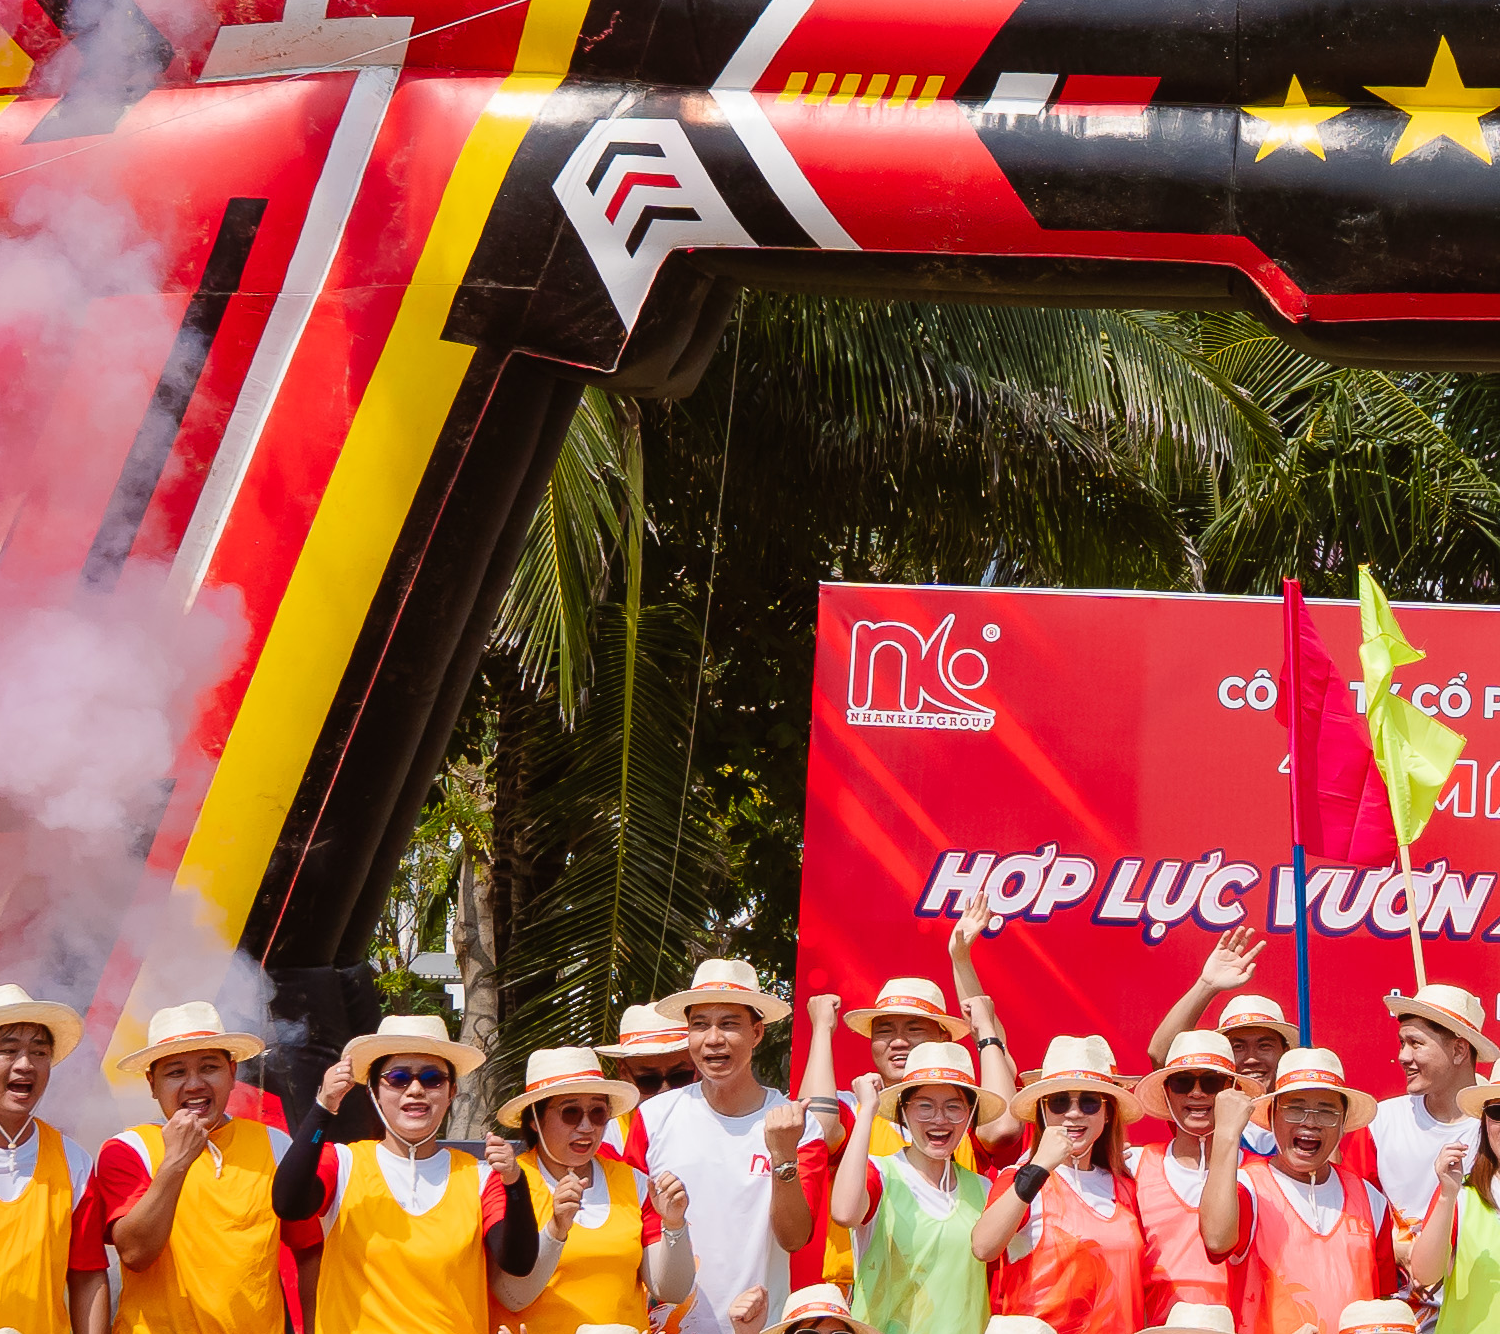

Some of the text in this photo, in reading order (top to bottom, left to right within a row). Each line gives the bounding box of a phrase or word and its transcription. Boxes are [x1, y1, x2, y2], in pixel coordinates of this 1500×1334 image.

[1217, 669, 1277, 711] CÔ
[1411, 671, 1472, 719] CỔ
[849, 710, 993, 730] NHANKIETGROUP
[916, 842, 1097, 935] HỢP
[1095, 847, 1259, 943] LỰC
